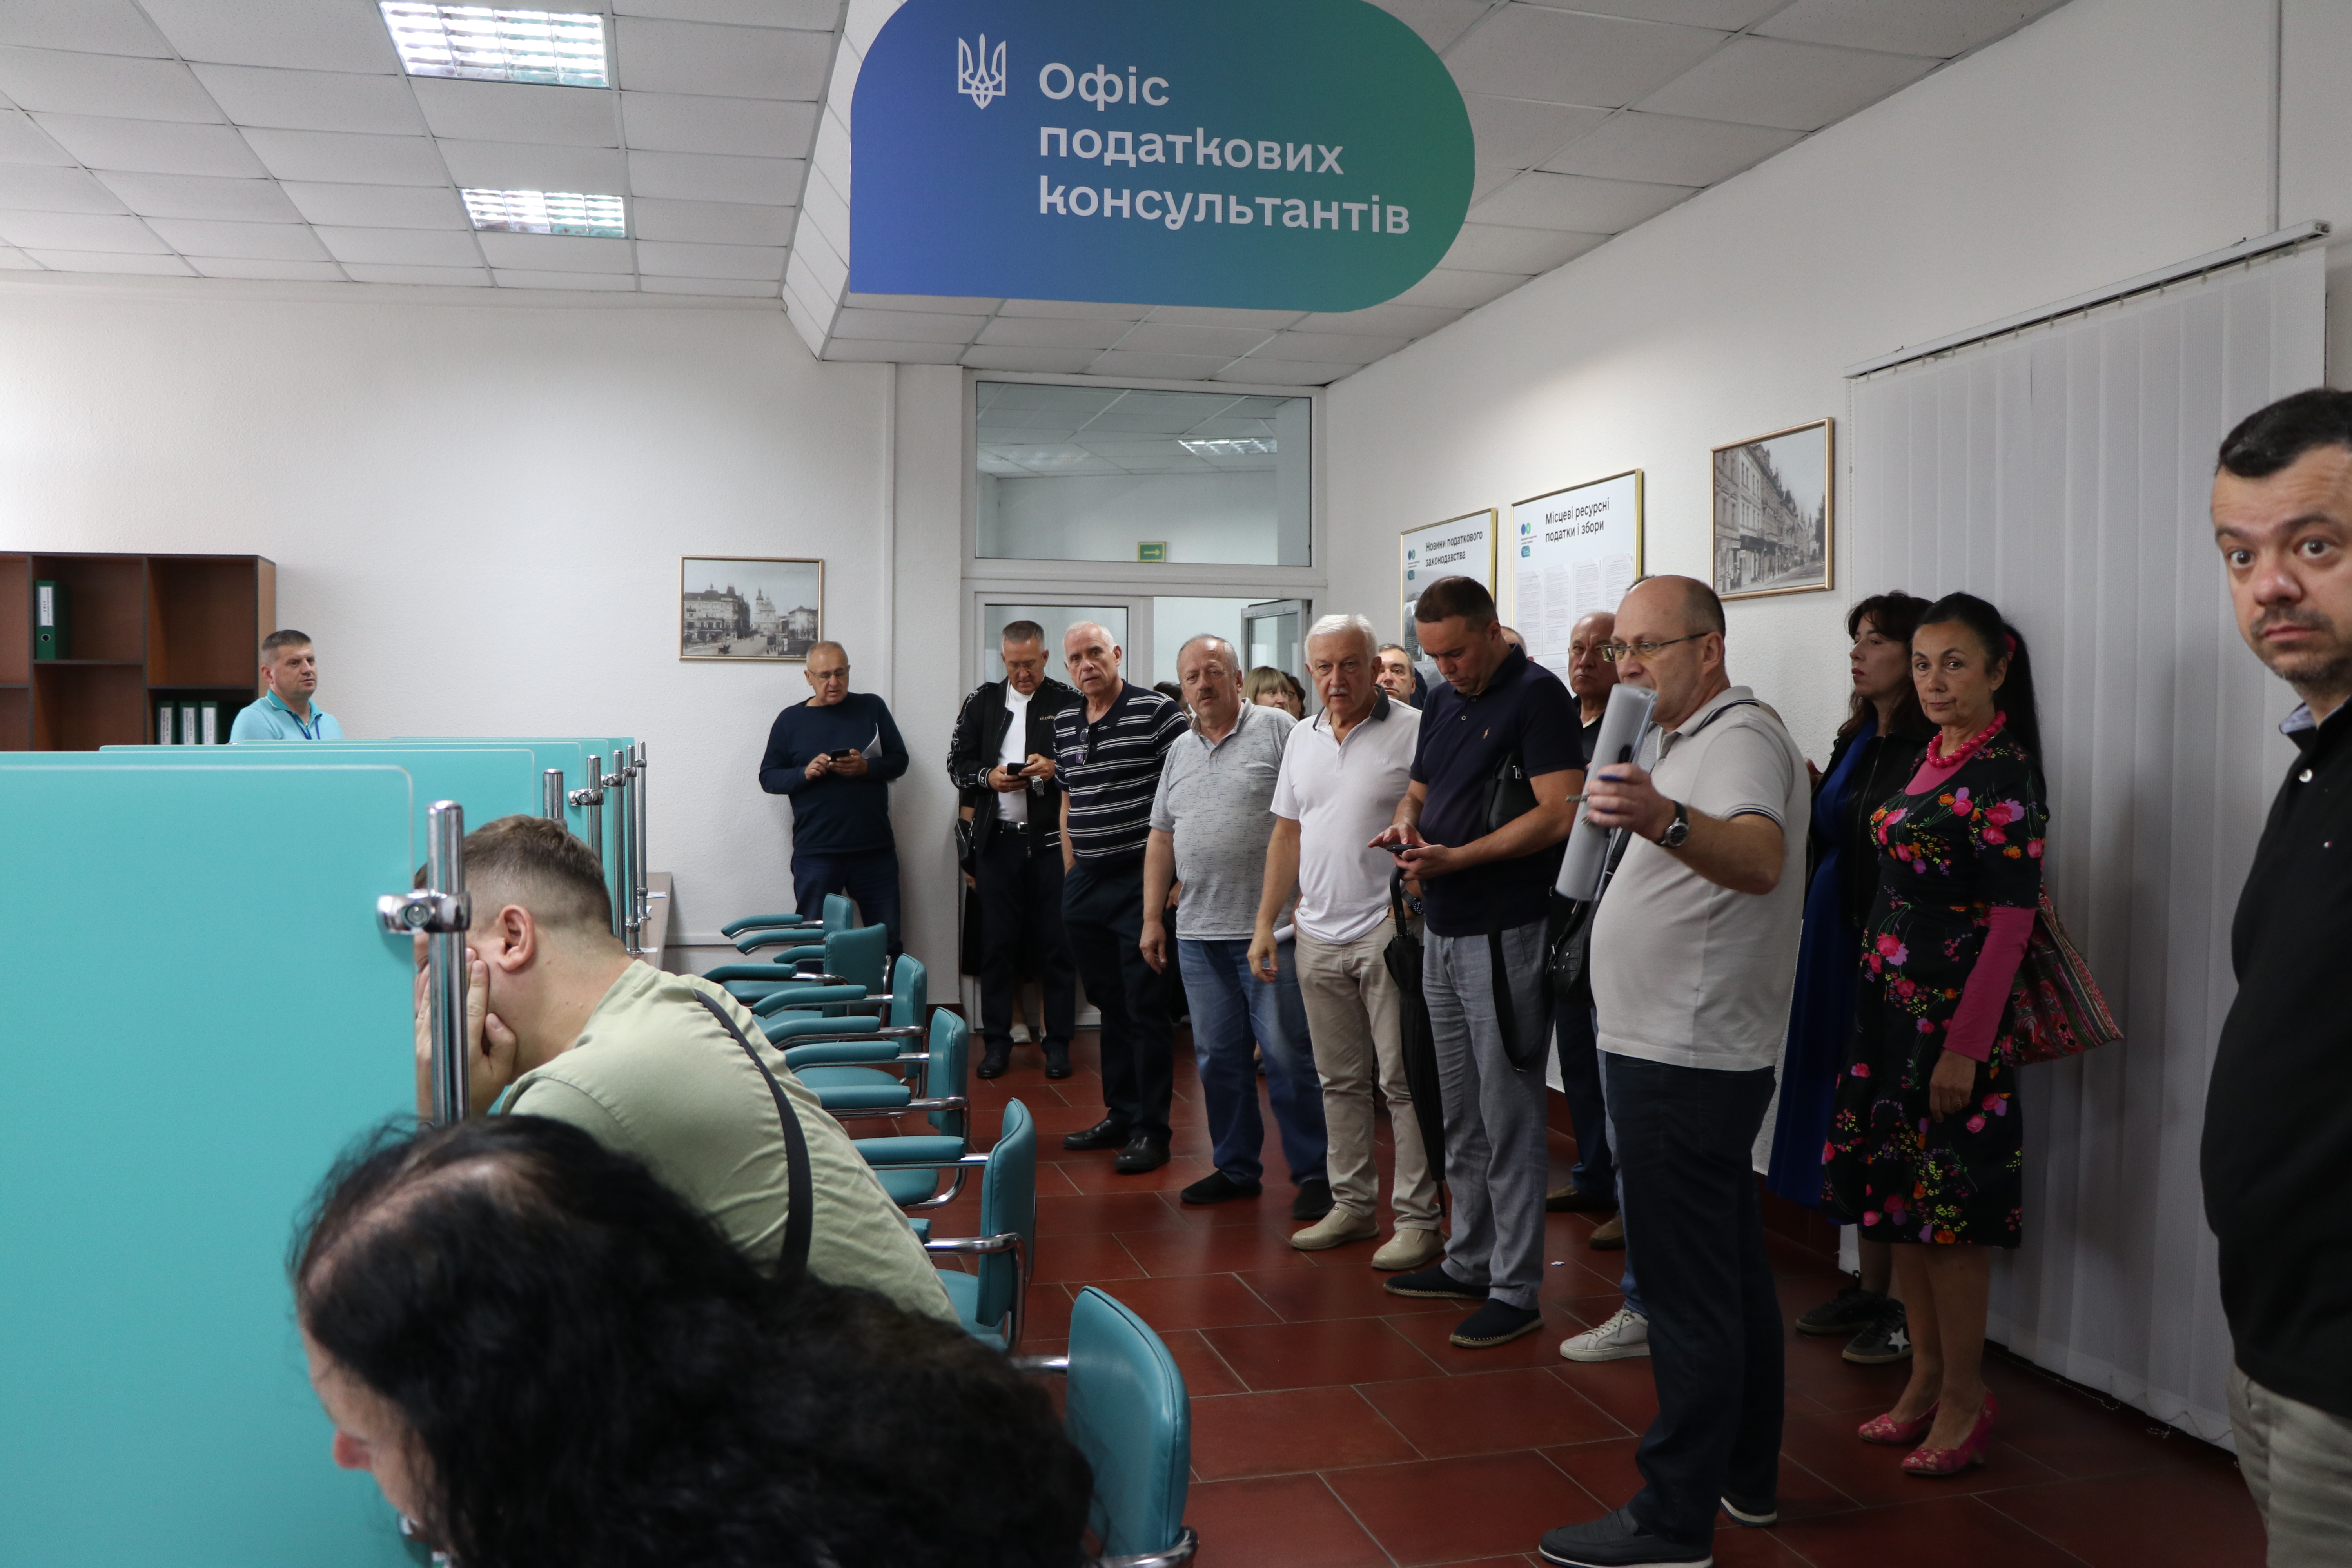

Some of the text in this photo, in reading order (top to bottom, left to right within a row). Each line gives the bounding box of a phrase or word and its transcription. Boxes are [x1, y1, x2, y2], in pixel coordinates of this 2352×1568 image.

[1039, 62, 1169, 111] Офіс
[1040, 127, 1345, 174] податкових
[1040, 175, 1410, 234] консультантів
[1546, 497, 1610, 525] Місцеві ресурсні
[1426, 531, 1483, 552] Новини податкового
[1545, 527, 1575, 543] податки
[1577, 523, 1580, 535] і
[1581, 520, 1604, 535] збори
[1426, 551, 1466, 567] законодавства
